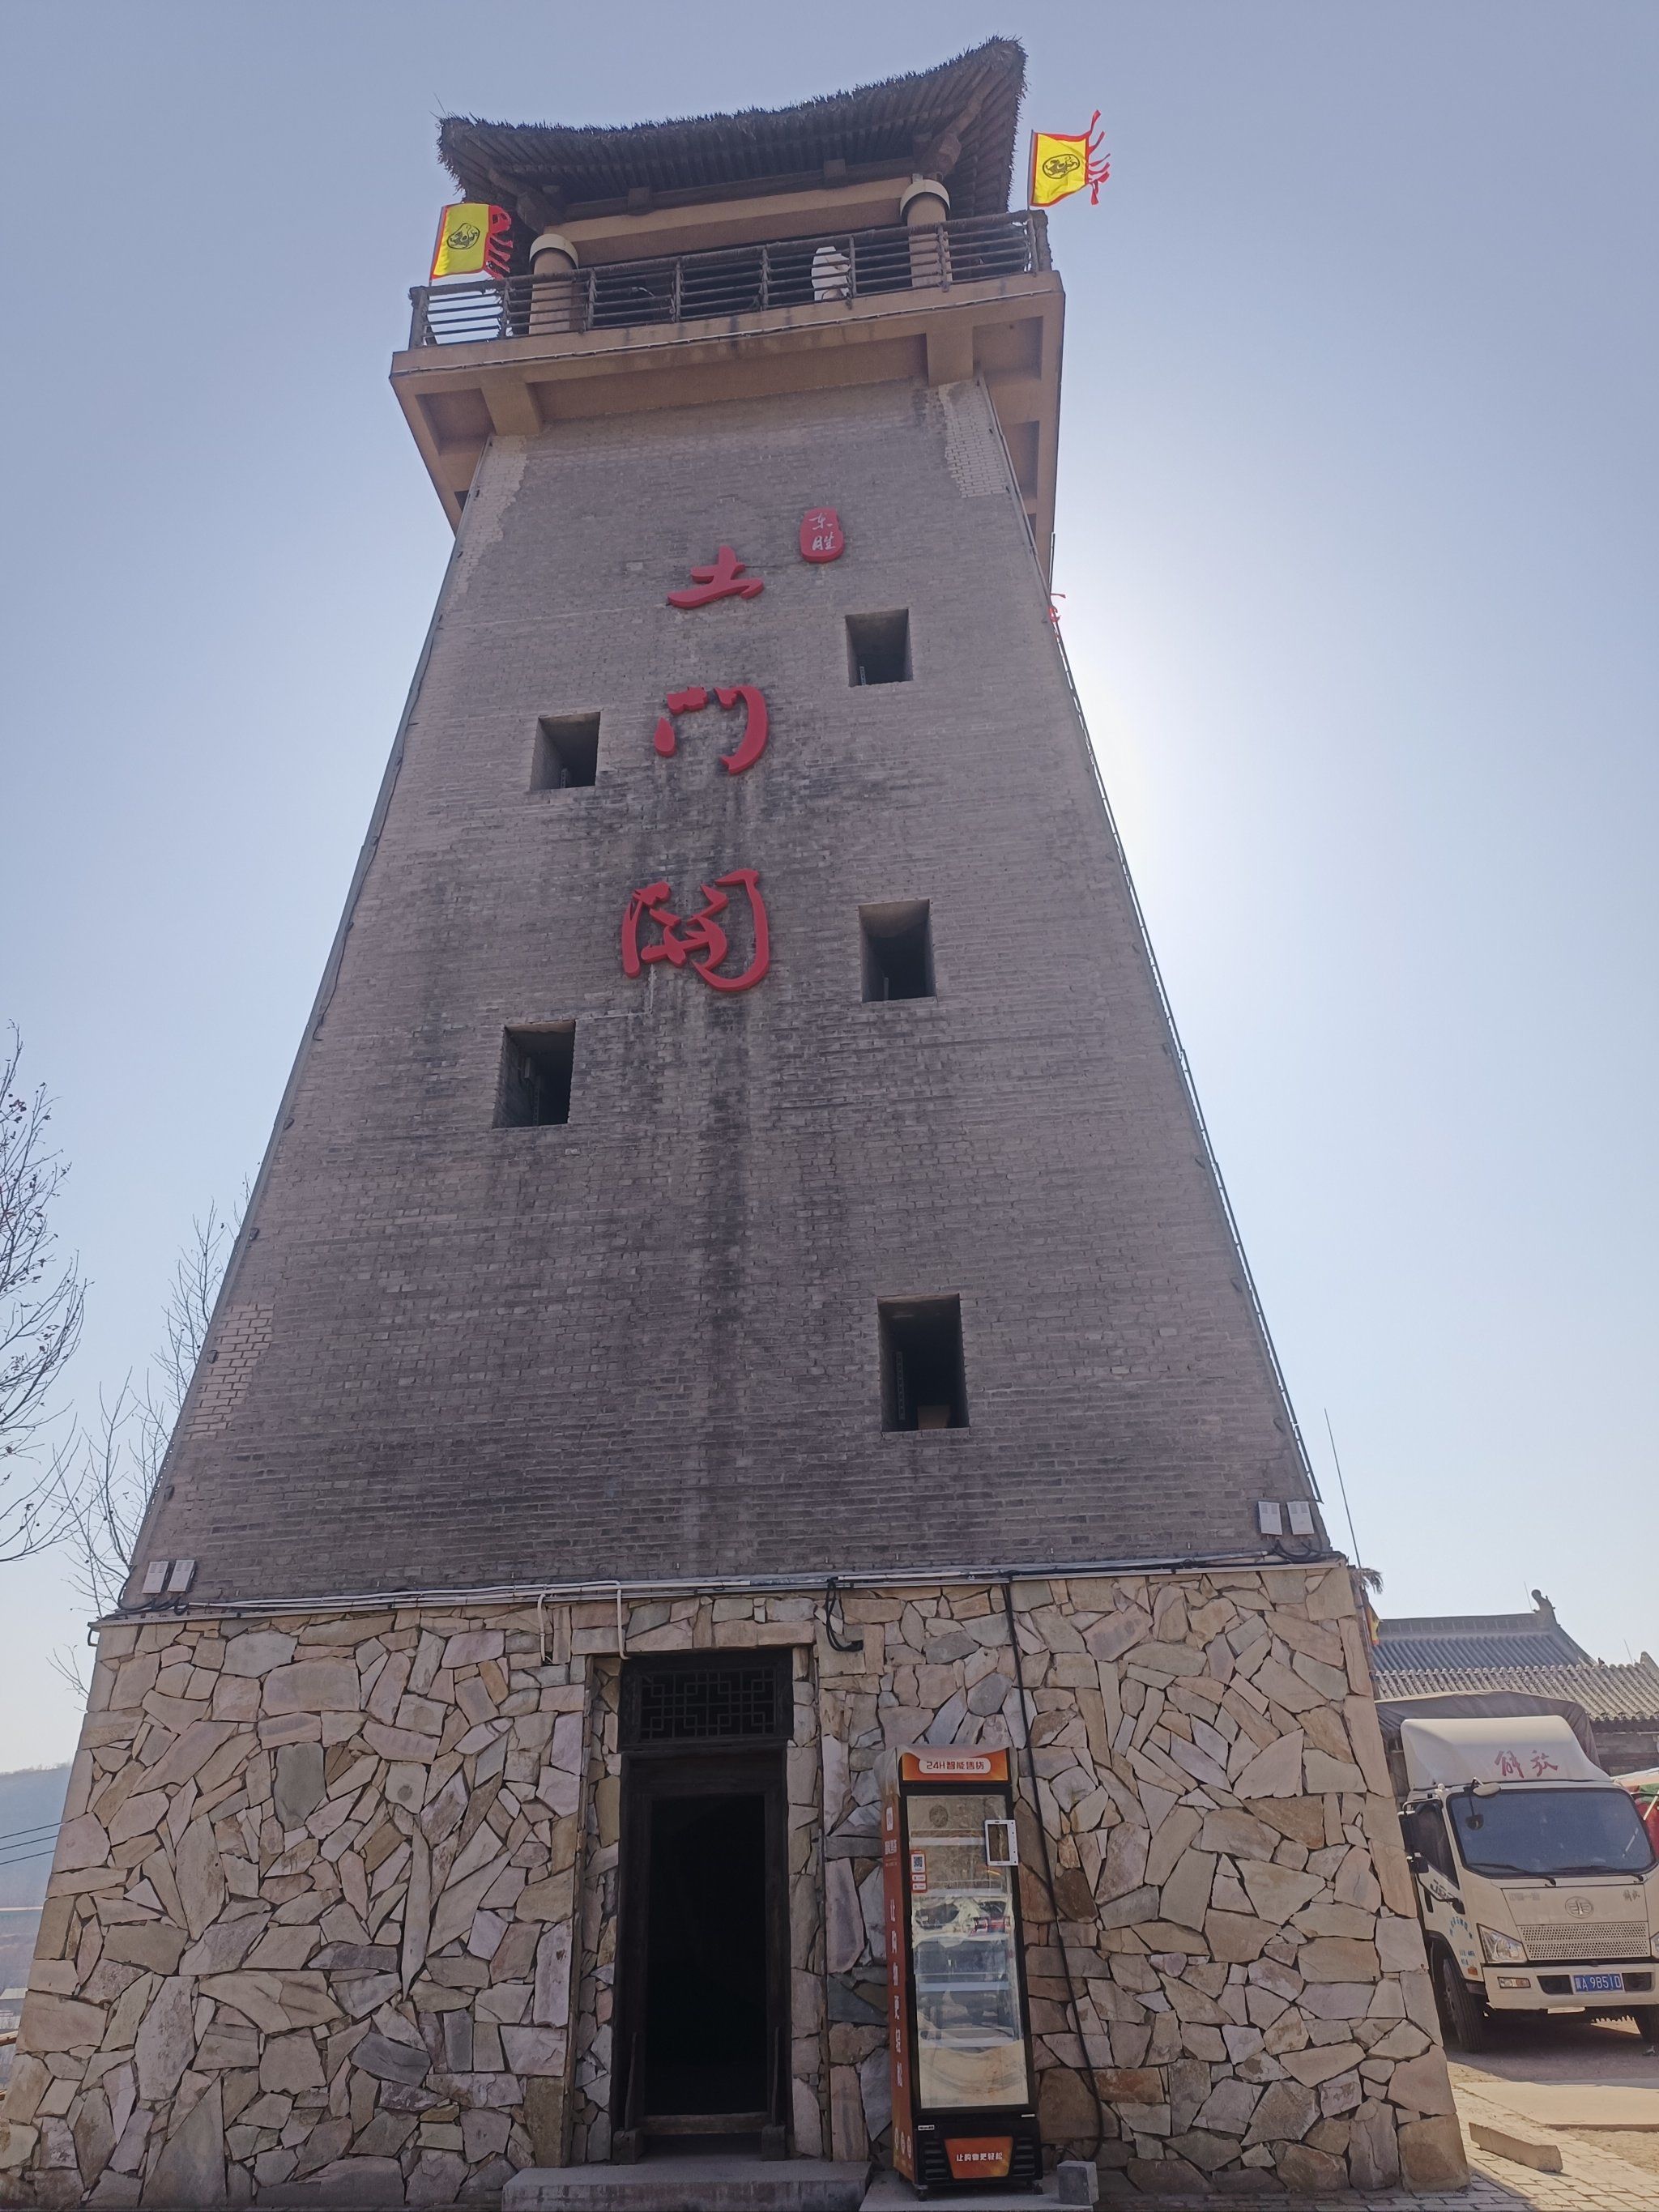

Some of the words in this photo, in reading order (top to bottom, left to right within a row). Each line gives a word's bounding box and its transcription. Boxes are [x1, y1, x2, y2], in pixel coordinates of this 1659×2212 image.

[1494, 1750, 1559, 1779] 解放
[956, 2151, 1003, 2162] 让购物更轻松
